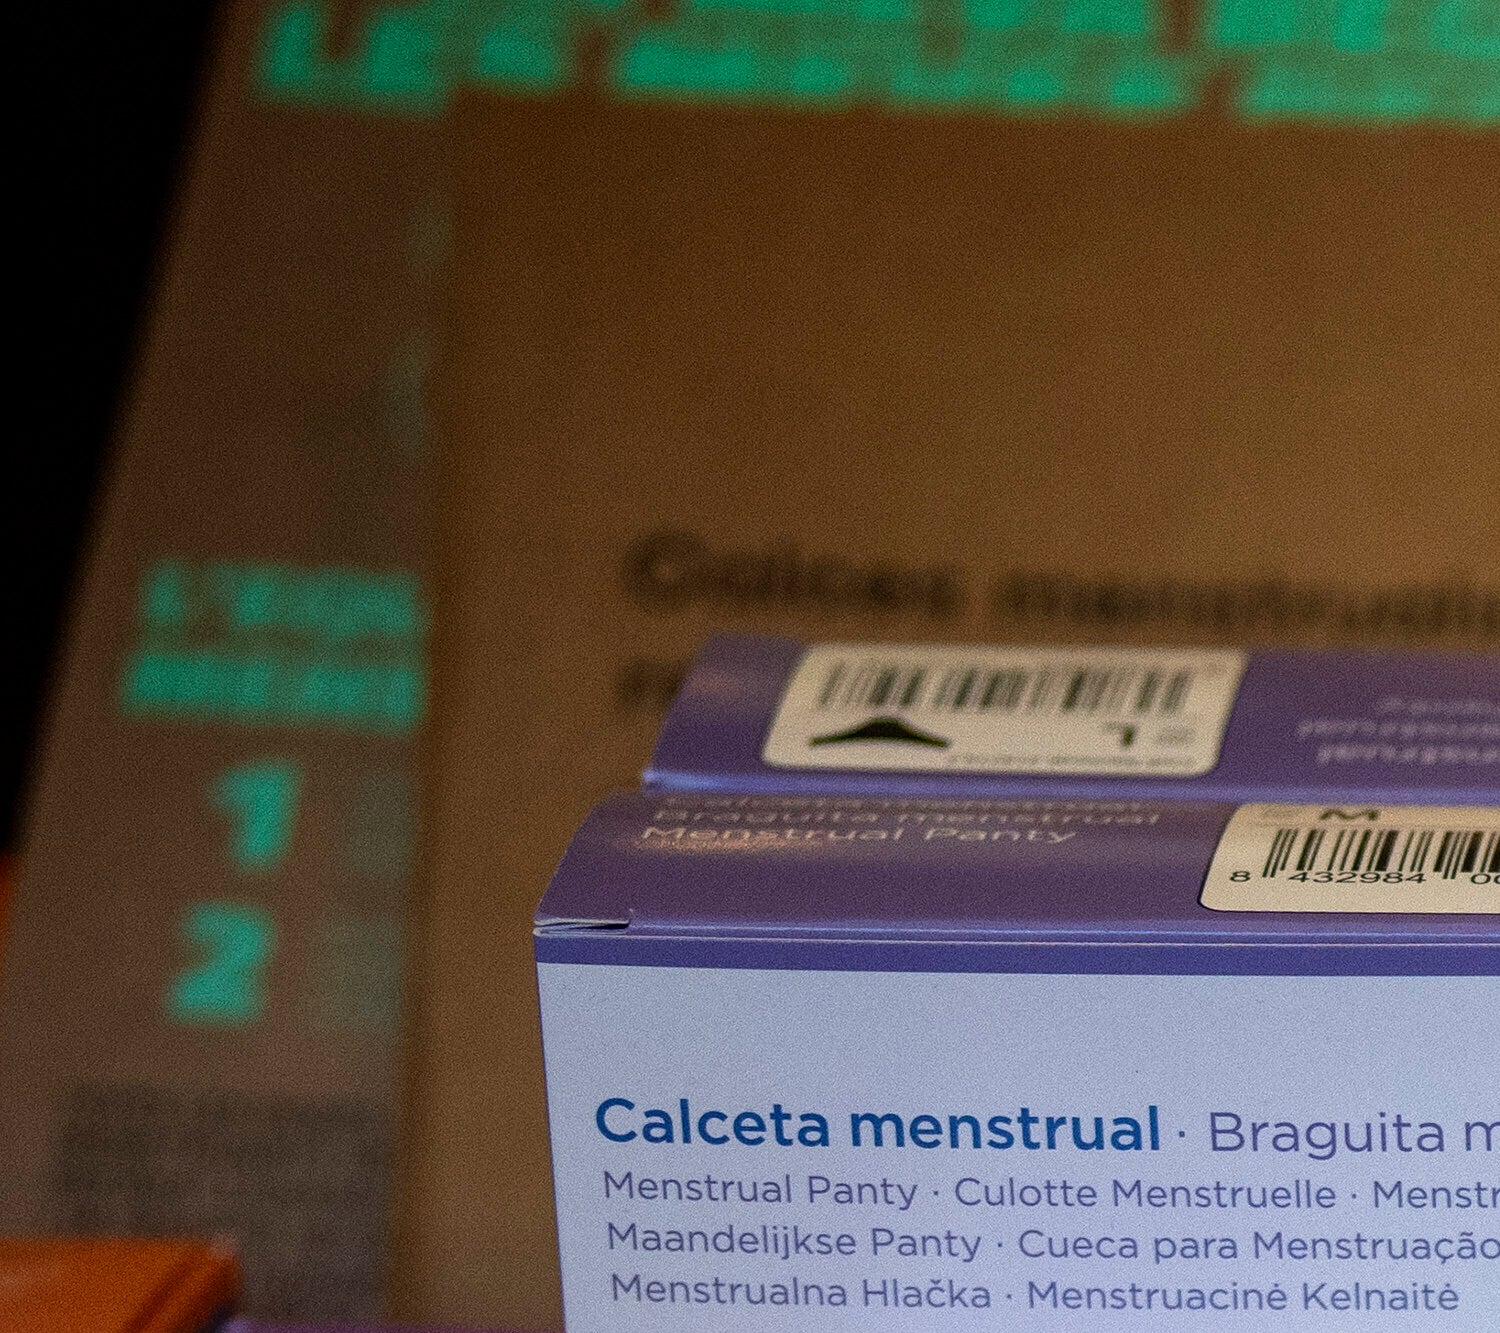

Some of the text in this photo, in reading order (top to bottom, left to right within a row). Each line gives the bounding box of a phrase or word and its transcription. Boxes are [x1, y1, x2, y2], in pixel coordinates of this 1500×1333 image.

[213, 760, 300, 873] 1
[641, 826, 1076, 844] Menstrual Panty
[1229, 870, 1251, 883] 8
[1287, 871, 1428, 885] 432984
[167, 900, 276, 1025] 2
[595, 1096, 831, 1148] Calceta
[850, 1104, 1161, 1152] menstrual
[1208, 1110, 1446, 1161] Braguita
[603, 1171, 793, 1204] Menstrual
[808, 1176, 918, 1211] Panty
[955, 1177, 1098, 1208] Culotte
[1113, 1178, 1337, 1209] Menstruelle
[608, 1222, 857, 1260] Maandelijkse
[872, 1228, 982, 1263] Panty
[1019, 1230, 1139, 1260] Cueca
[1154, 1236, 1239, 1264] para
[611, 1273, 1460, 1312] Menstrualna Hlačka Menstruacinė Kelnaitė
